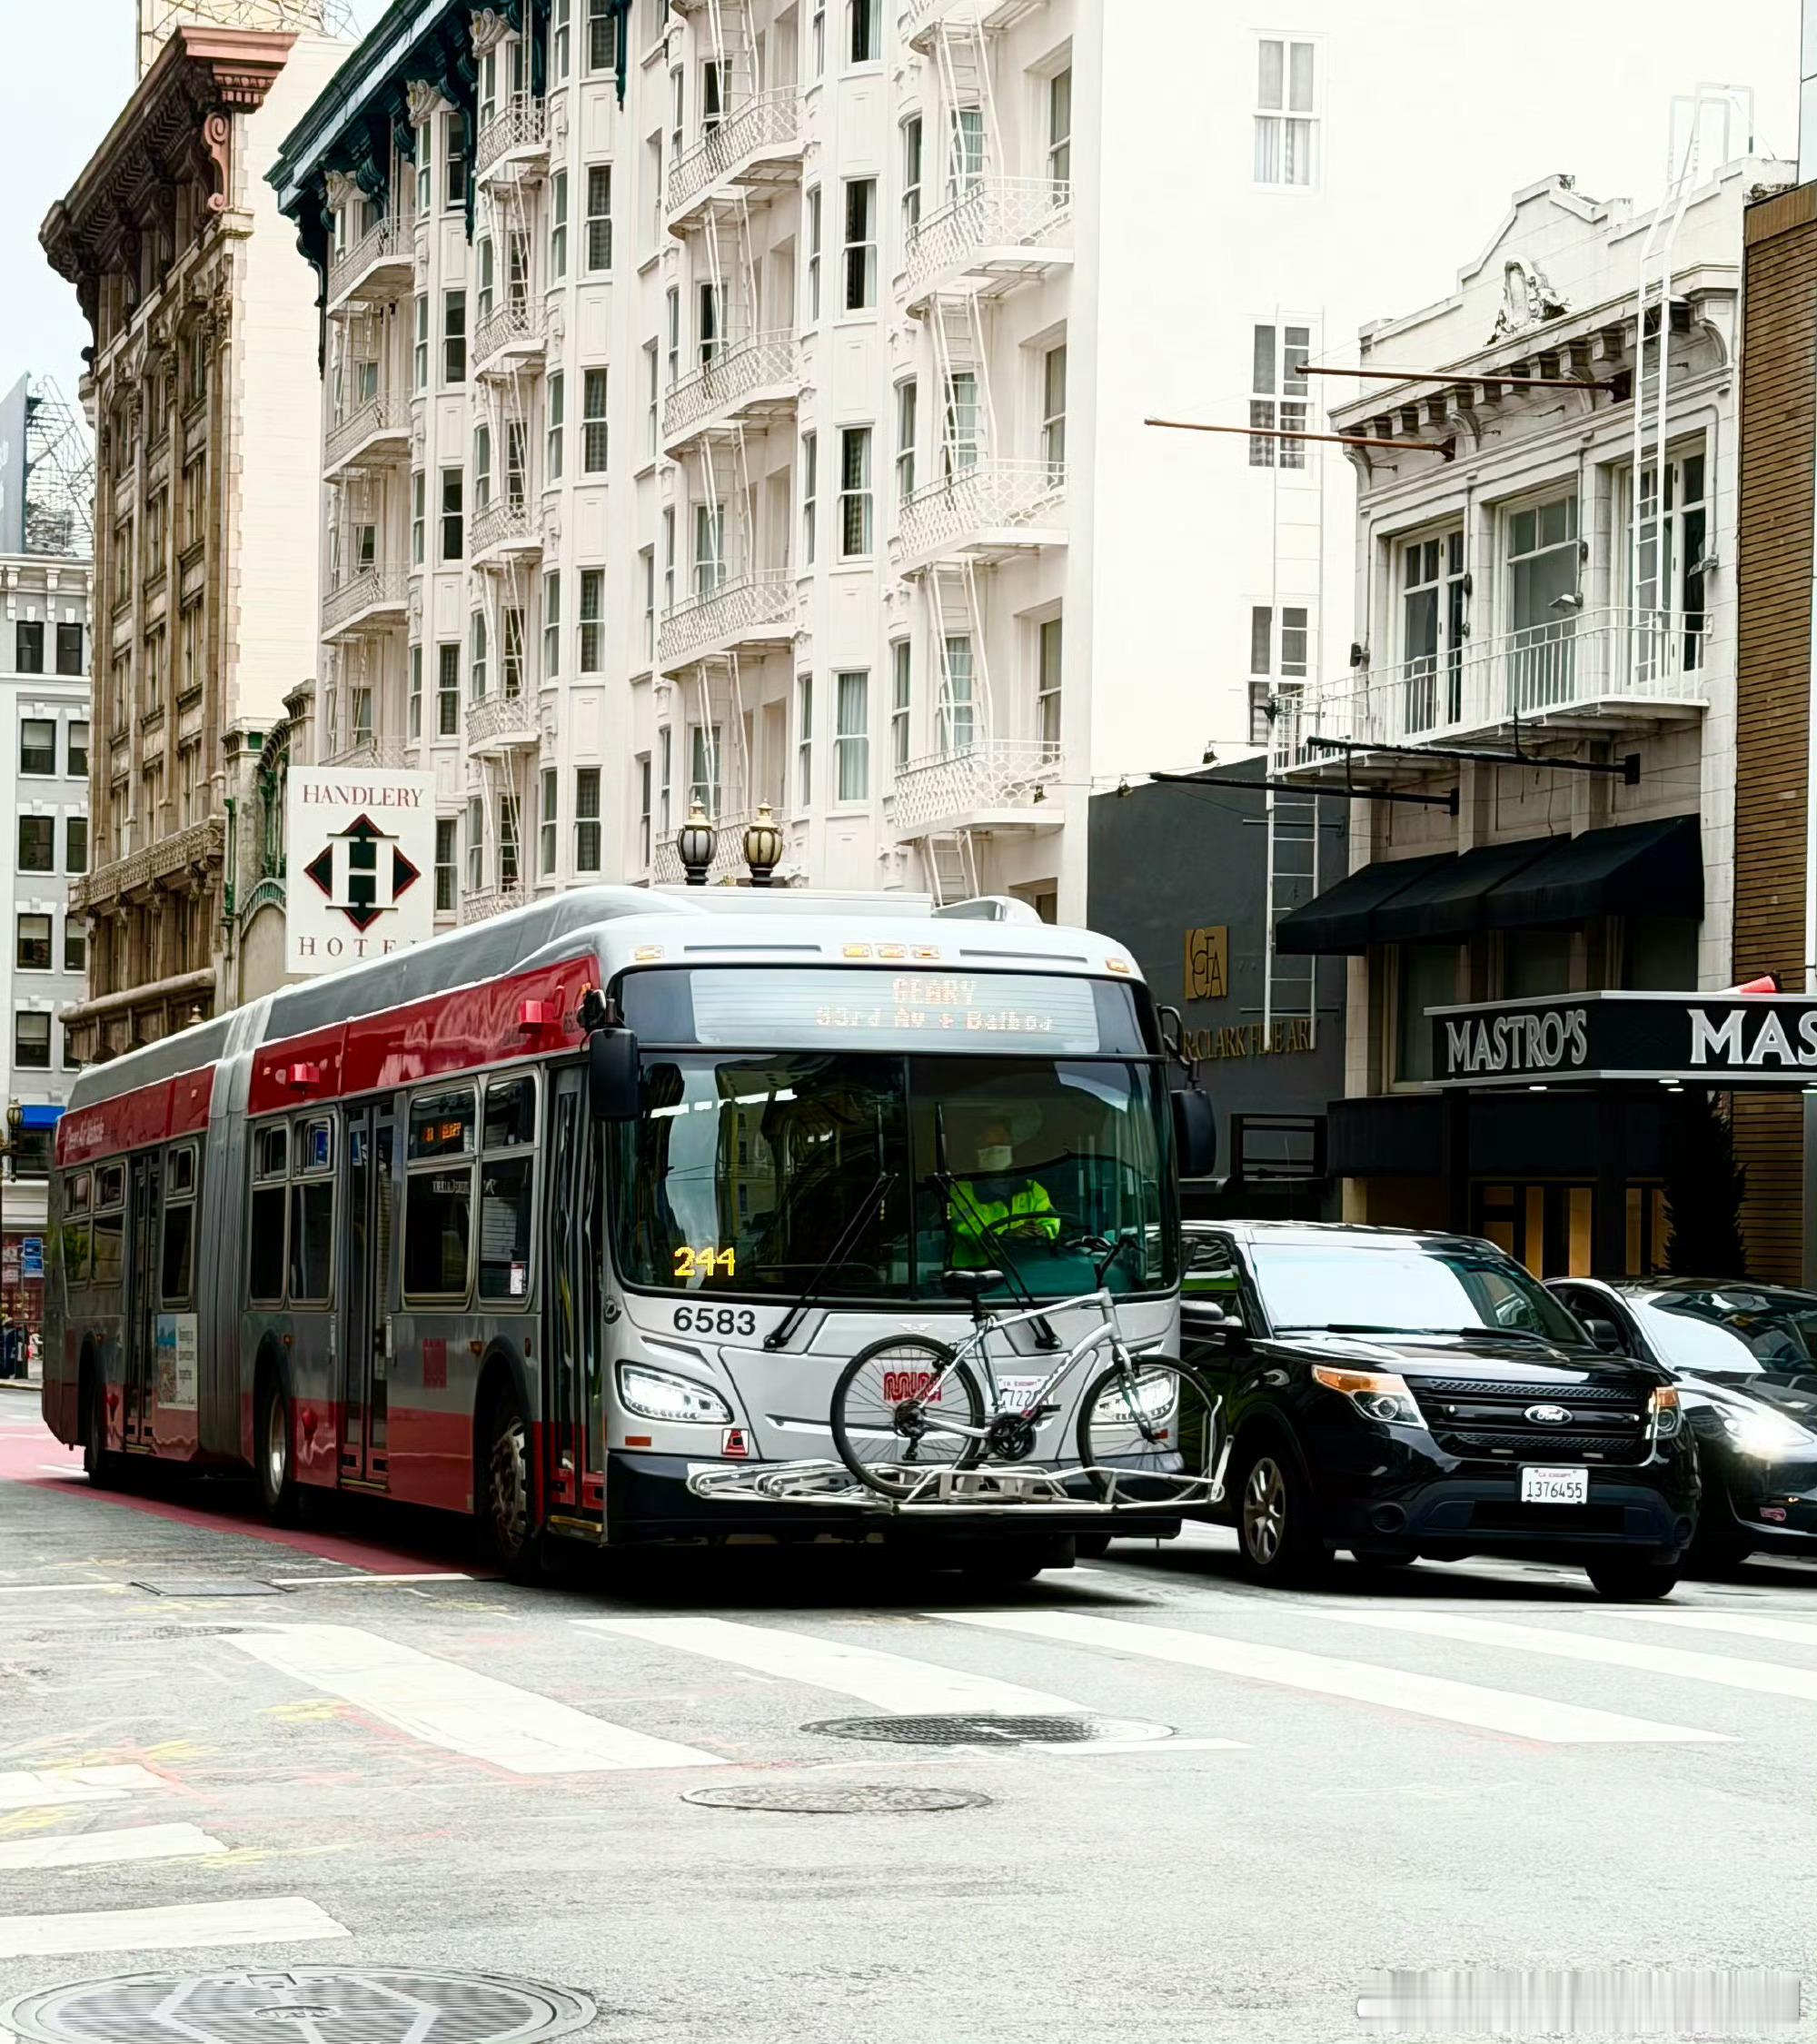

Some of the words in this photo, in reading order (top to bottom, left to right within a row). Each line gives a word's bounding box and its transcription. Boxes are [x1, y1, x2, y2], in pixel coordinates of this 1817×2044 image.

[303, 784, 424, 808] HANDLERY
[298, 937, 421, 958] HOTE
[1445, 1008, 1587, 1073] MASTRO'S
[674, 1246, 736, 1276] 244
[673, 1306, 756, 1336] 6583
[1527, 1481, 1583, 1499] 1376455
